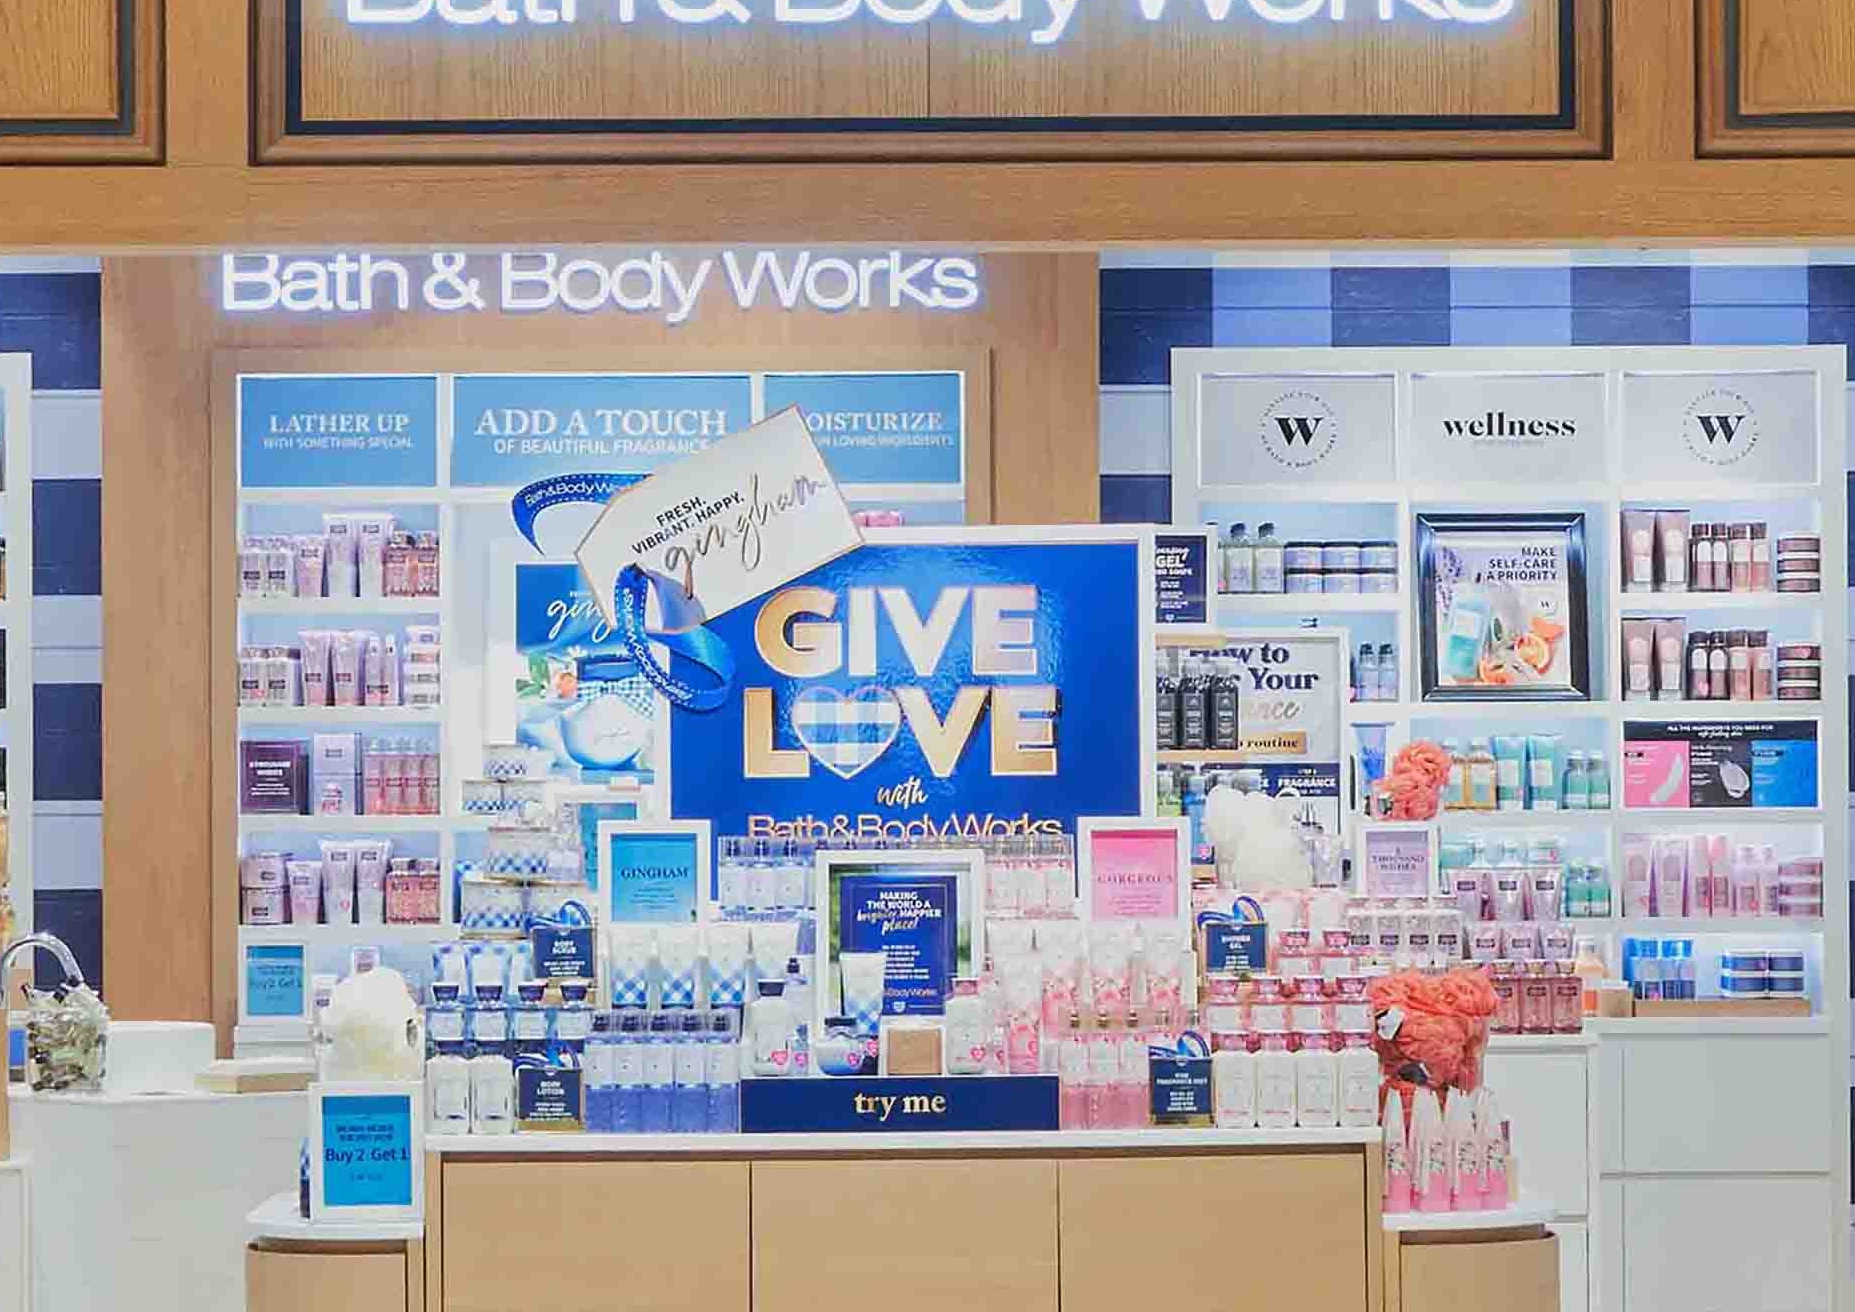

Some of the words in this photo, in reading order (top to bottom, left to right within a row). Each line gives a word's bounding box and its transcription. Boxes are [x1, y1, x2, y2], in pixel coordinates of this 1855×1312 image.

[222, 253, 408, 311] Bath
[423, 253, 484, 311] &
[500, 253, 712, 325] Body
[718, 253, 979, 311] Works
[270, 414, 370, 434] LATHER
[377, 414, 410, 434] UP
[474, 408, 557, 436] ADD
[563, 408, 591, 436] A
[596, 408, 729, 436] TOUCH
[805, 411, 943, 431] OISTURIZE
[1274, 417, 1324, 446] W
[1442, 411, 1577, 436] wellness
[1696, 416, 1746, 444] W
[494, 439, 515, 454] OF
[521, 439, 611, 455] BEAUTIFUL
[631, 517, 695, 555] VIBRANT.
[696, 490, 746, 524] HAPPY.
[656, 495, 707, 527] FRESH.
[1521, 546, 1556, 557] MAKE
[1489, 558, 1556, 569] SELF-CARE
[1486, 570, 1495, 581] A
[1497, 570, 1557, 581] PRIORITY
[753, 584, 1039, 679] GIVE
[1260, 642, 1291, 664] to
[1248, 666, 1320, 690] Your
[1247, 736, 1300, 749] routine
[875, 775, 930, 810] with
[620, 866, 689, 879] GINGHAM
[1097, 872, 1173, 884] GORGEOUS
[854, 1092, 895, 1122] try
[902, 1094, 947, 1114] me
[325, 1147, 354, 1165] Buy
[355, 1147, 365, 1162] 2
[370, 1147, 396, 1162] Get
